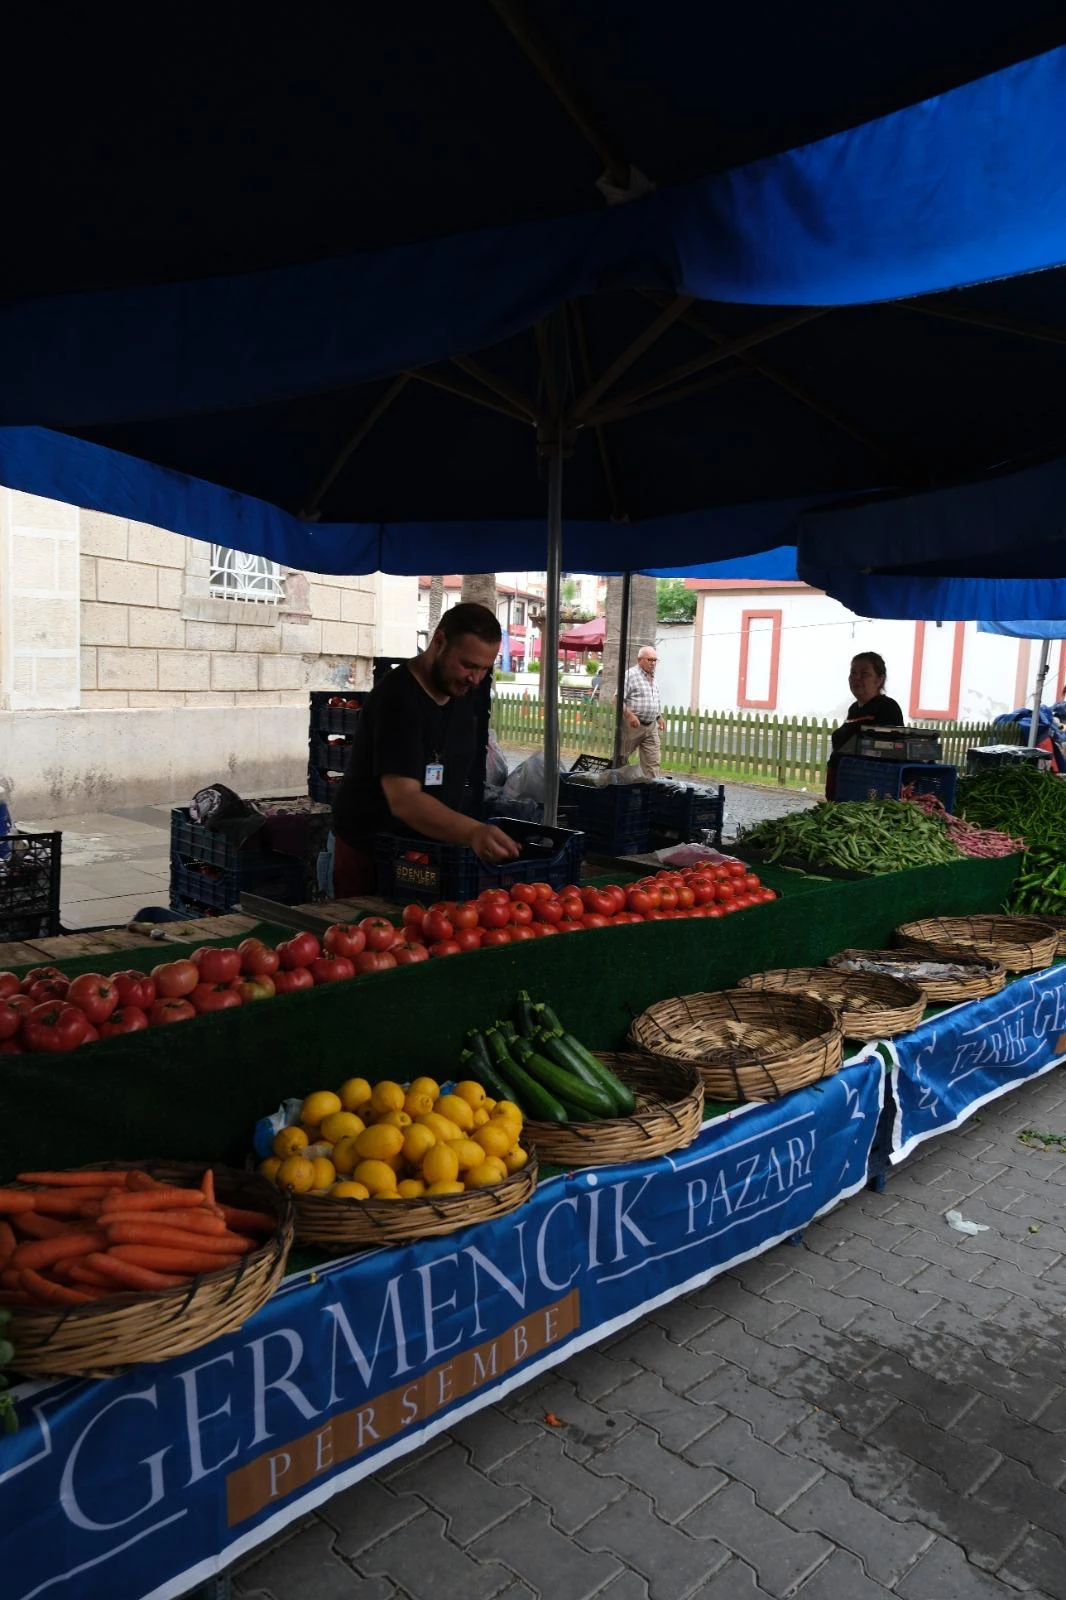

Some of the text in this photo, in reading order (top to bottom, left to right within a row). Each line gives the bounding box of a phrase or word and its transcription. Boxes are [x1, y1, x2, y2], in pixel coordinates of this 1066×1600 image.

[950, 982, 1066, 1074] TARİHİ GE
[59, 1128, 817, 1531] GERMENCİK PAZARI
